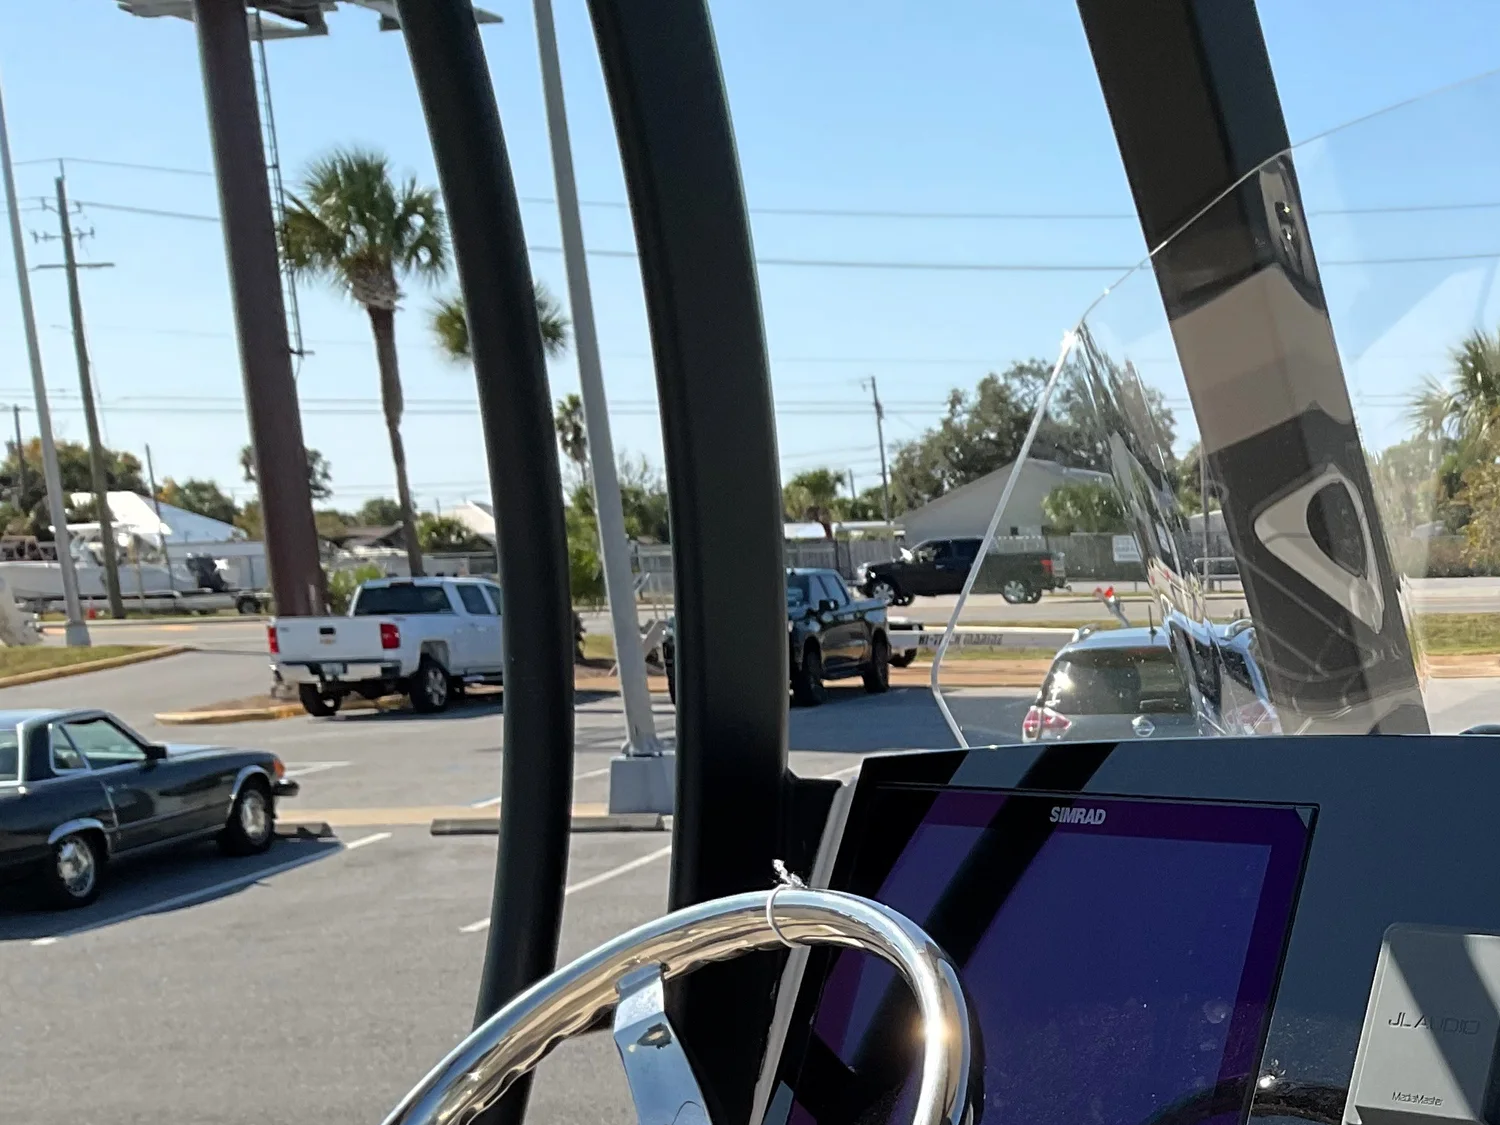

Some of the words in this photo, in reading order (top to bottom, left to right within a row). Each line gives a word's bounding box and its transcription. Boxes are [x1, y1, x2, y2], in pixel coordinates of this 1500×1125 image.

[1049, 806, 1106, 825] SIMRAD
[1388, 1011, 1411, 1027] JL
[1391, 1091, 1443, 1106] MediaMaster
